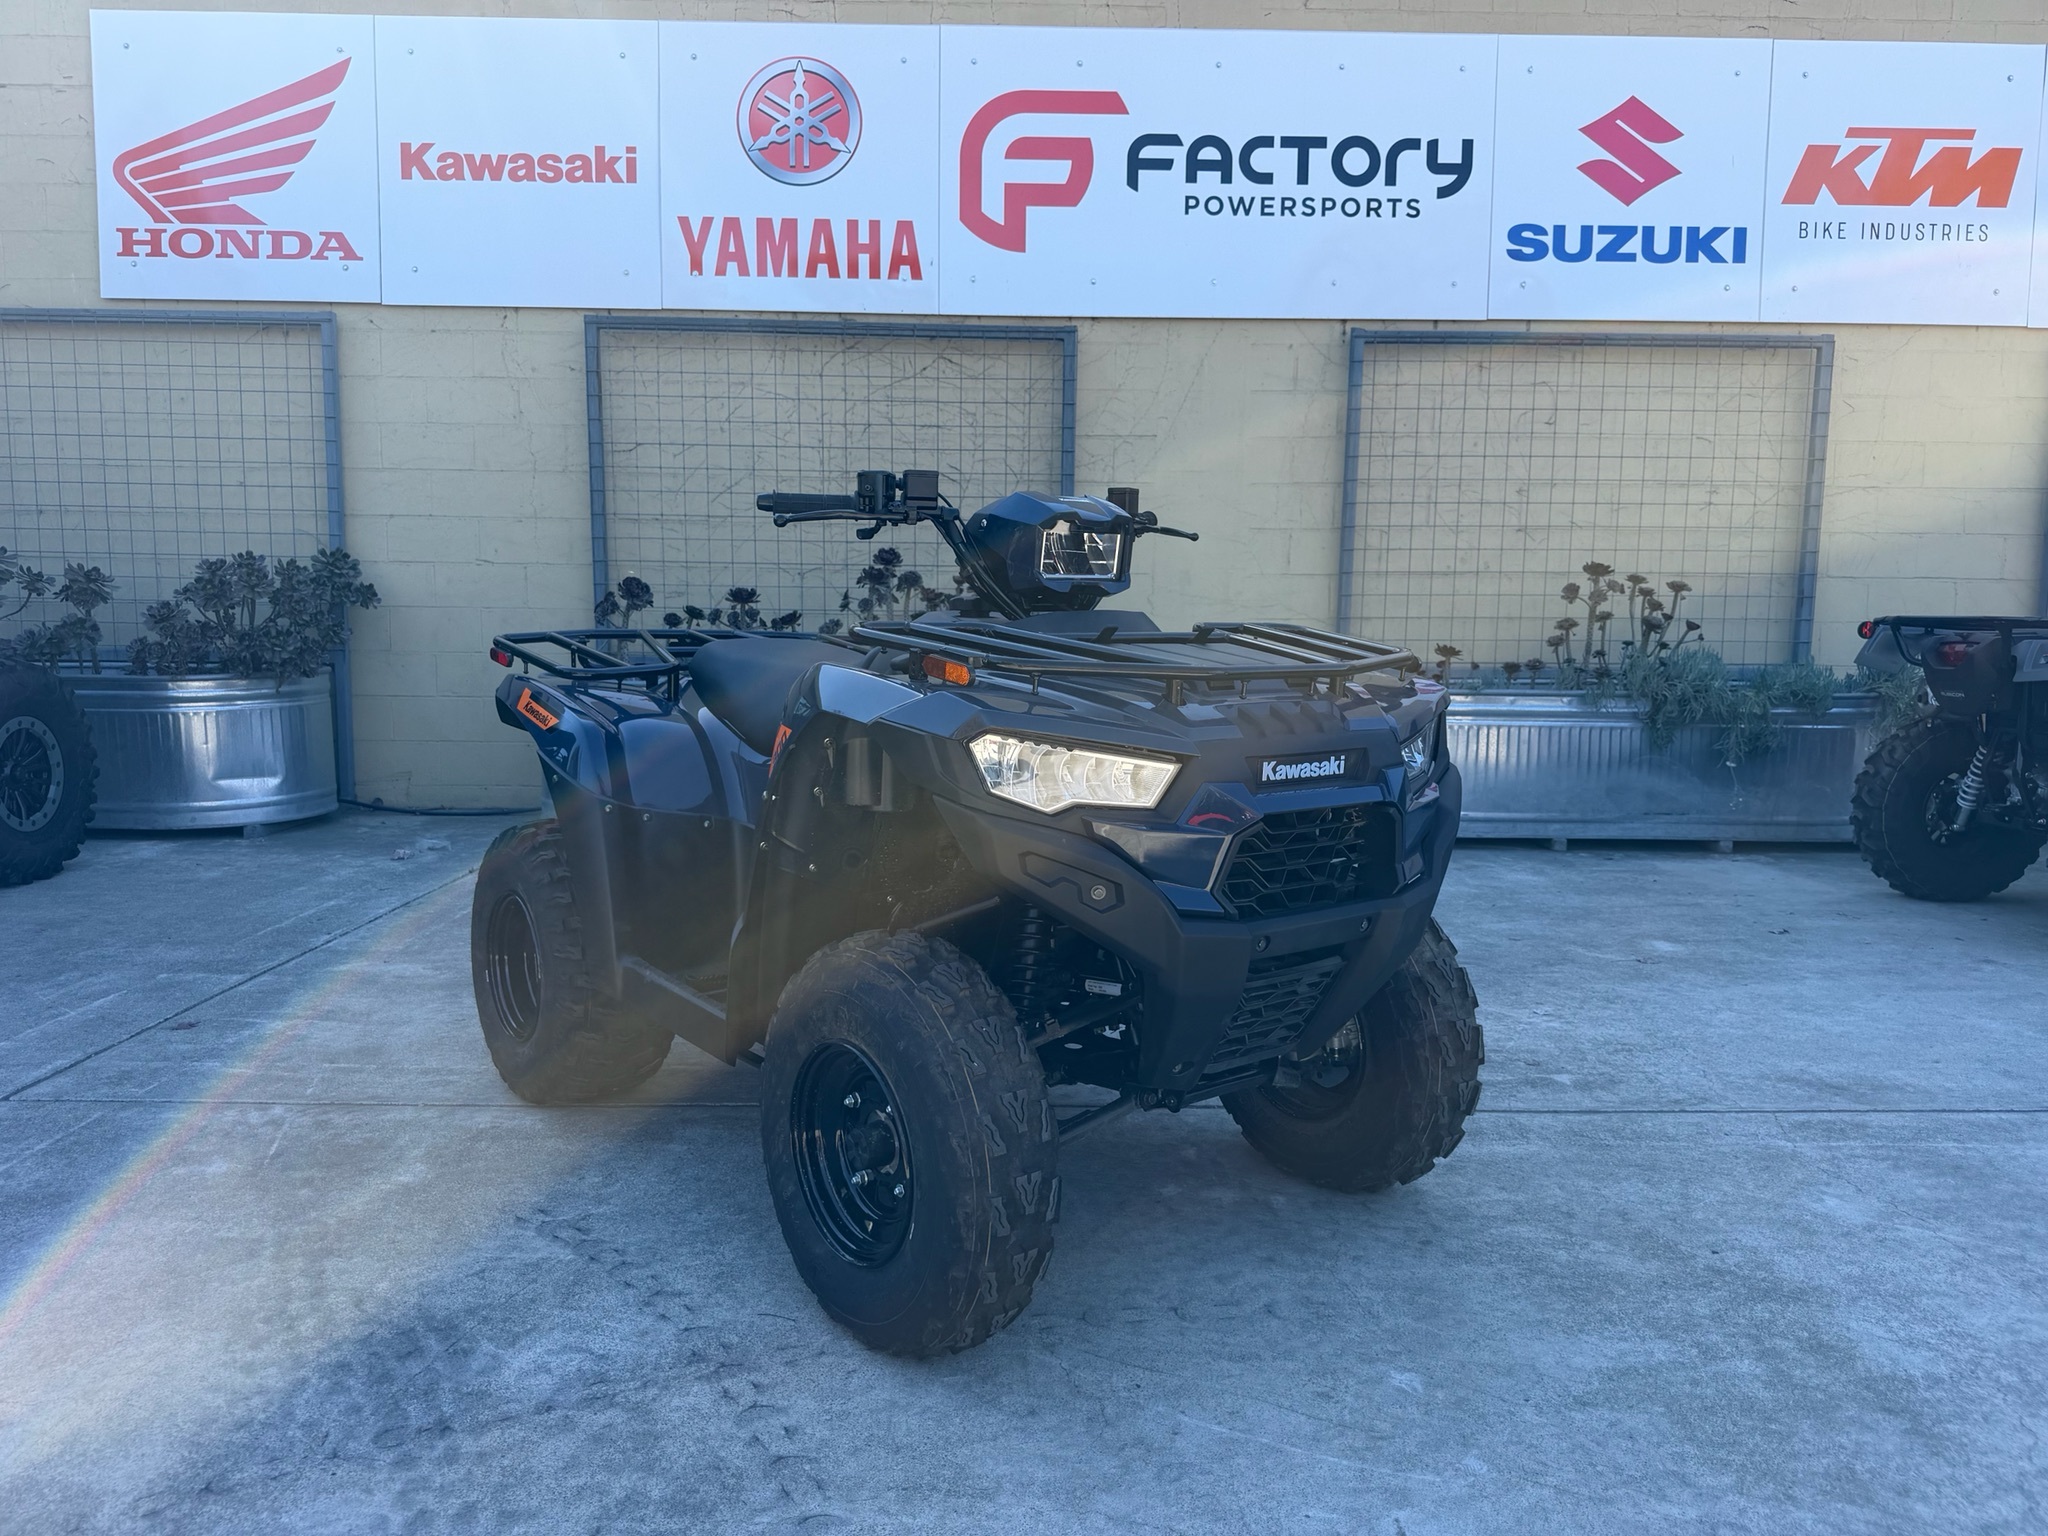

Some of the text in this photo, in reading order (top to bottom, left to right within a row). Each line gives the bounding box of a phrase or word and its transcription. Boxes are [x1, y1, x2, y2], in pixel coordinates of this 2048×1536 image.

[399, 141, 638, 185] Kawasaki
[1781, 126, 2023, 209] KTM
[1184, 195, 1421, 219] POWERSPORTS
[116, 227, 364, 262] HONDA
[677, 215, 923, 281] YAMAHA
[1506, 222, 1747, 265] SUZUKI
[1798, 220, 1989, 243] BIKE INDUSTRIES
[523, 699, 553, 728] Kawasaki
[1261, 754, 1346, 782] Kawasaki
